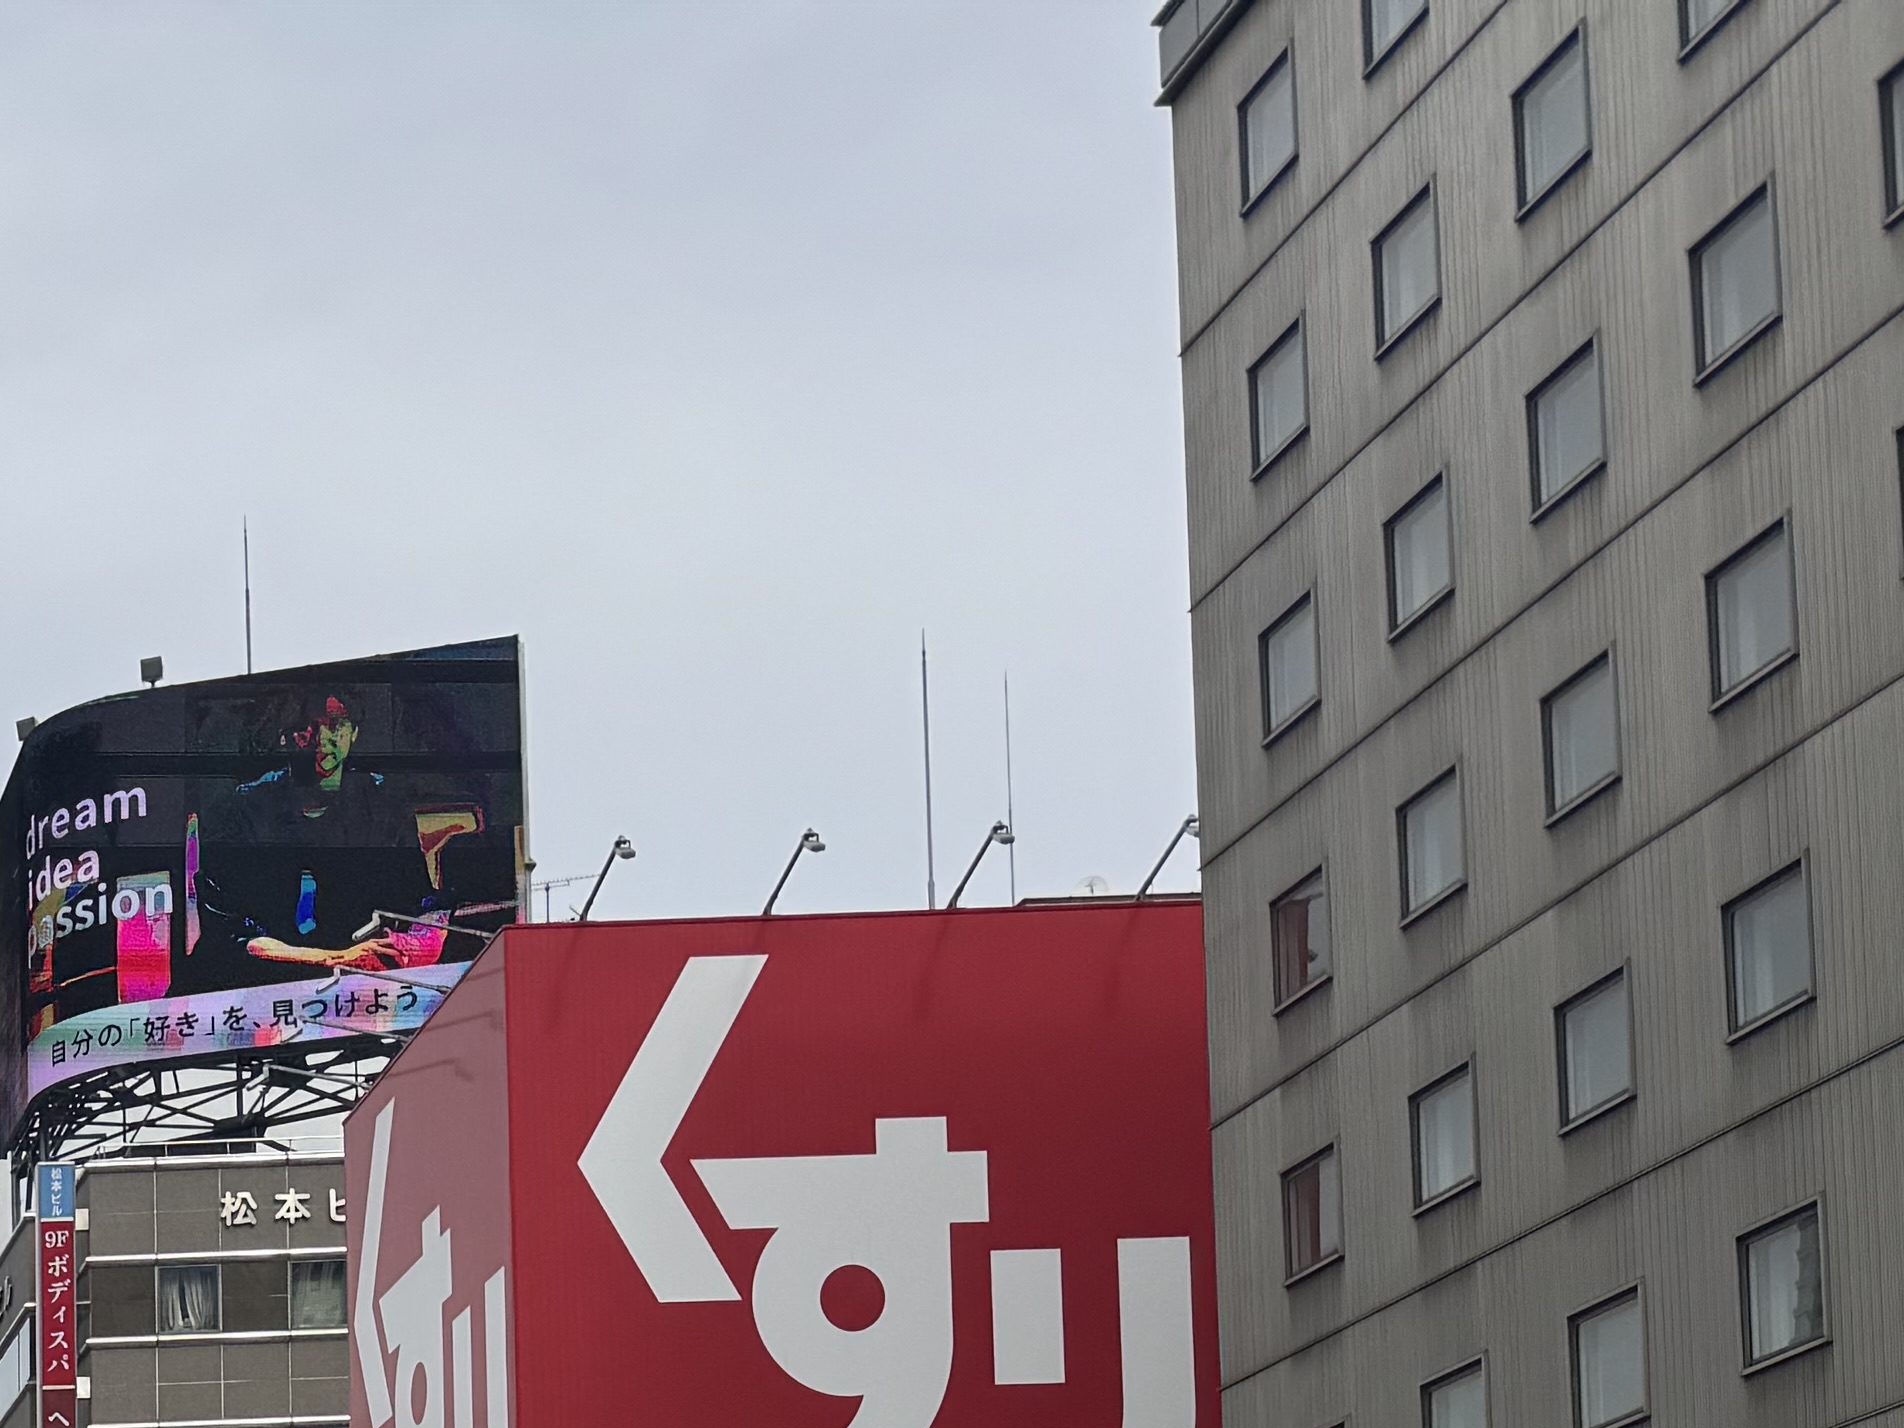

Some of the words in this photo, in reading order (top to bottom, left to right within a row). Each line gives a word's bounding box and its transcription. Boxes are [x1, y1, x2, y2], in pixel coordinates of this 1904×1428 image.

[26, 786, 148, 861] dream
[28, 848, 101, 903] idea
[27, 882, 174, 970] passion
[44, 1230, 70, 1250] 9F
[46, 1256, 72, 1373] ボディスパ
